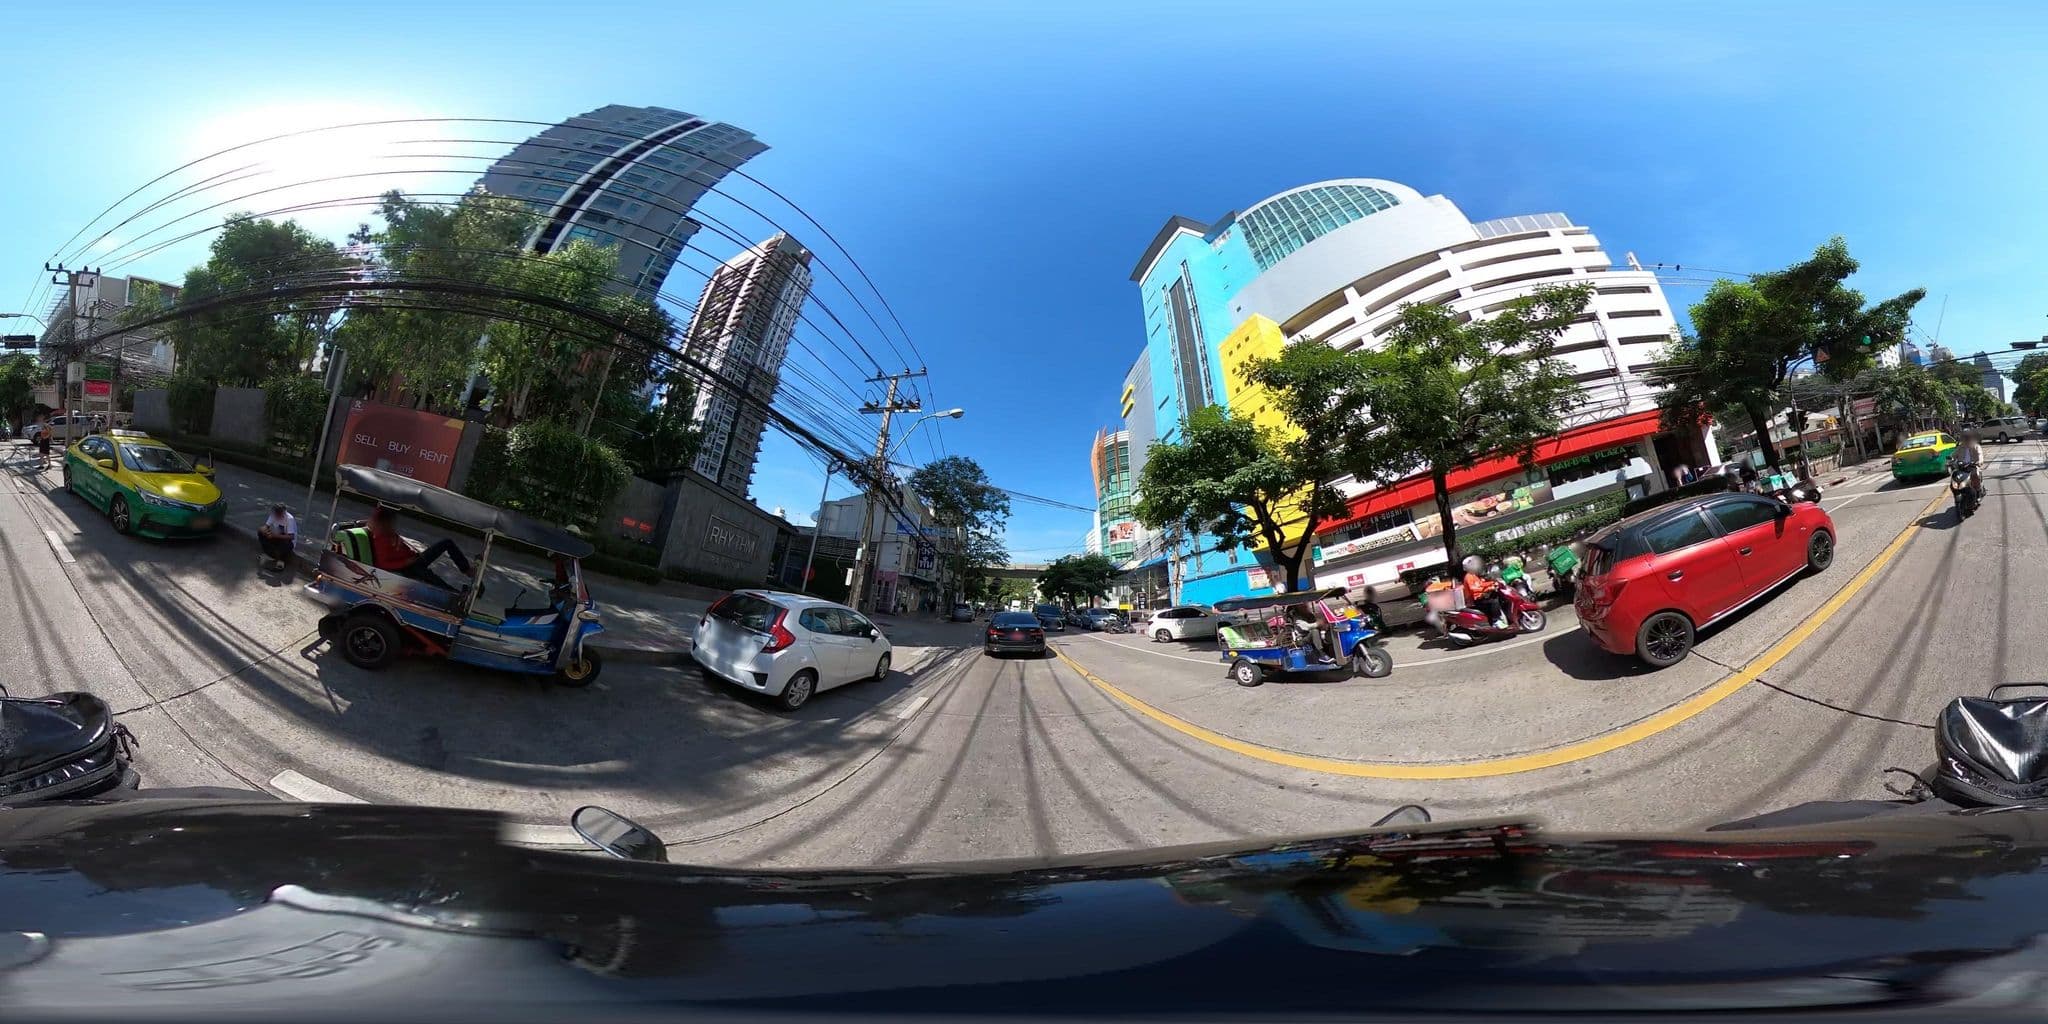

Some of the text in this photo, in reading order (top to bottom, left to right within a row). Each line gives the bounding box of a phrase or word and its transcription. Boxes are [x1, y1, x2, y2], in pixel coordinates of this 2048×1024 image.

[354, 433, 448, 464] SELL BUY RENT
[709, 526, 756, 555] RHYTHM
